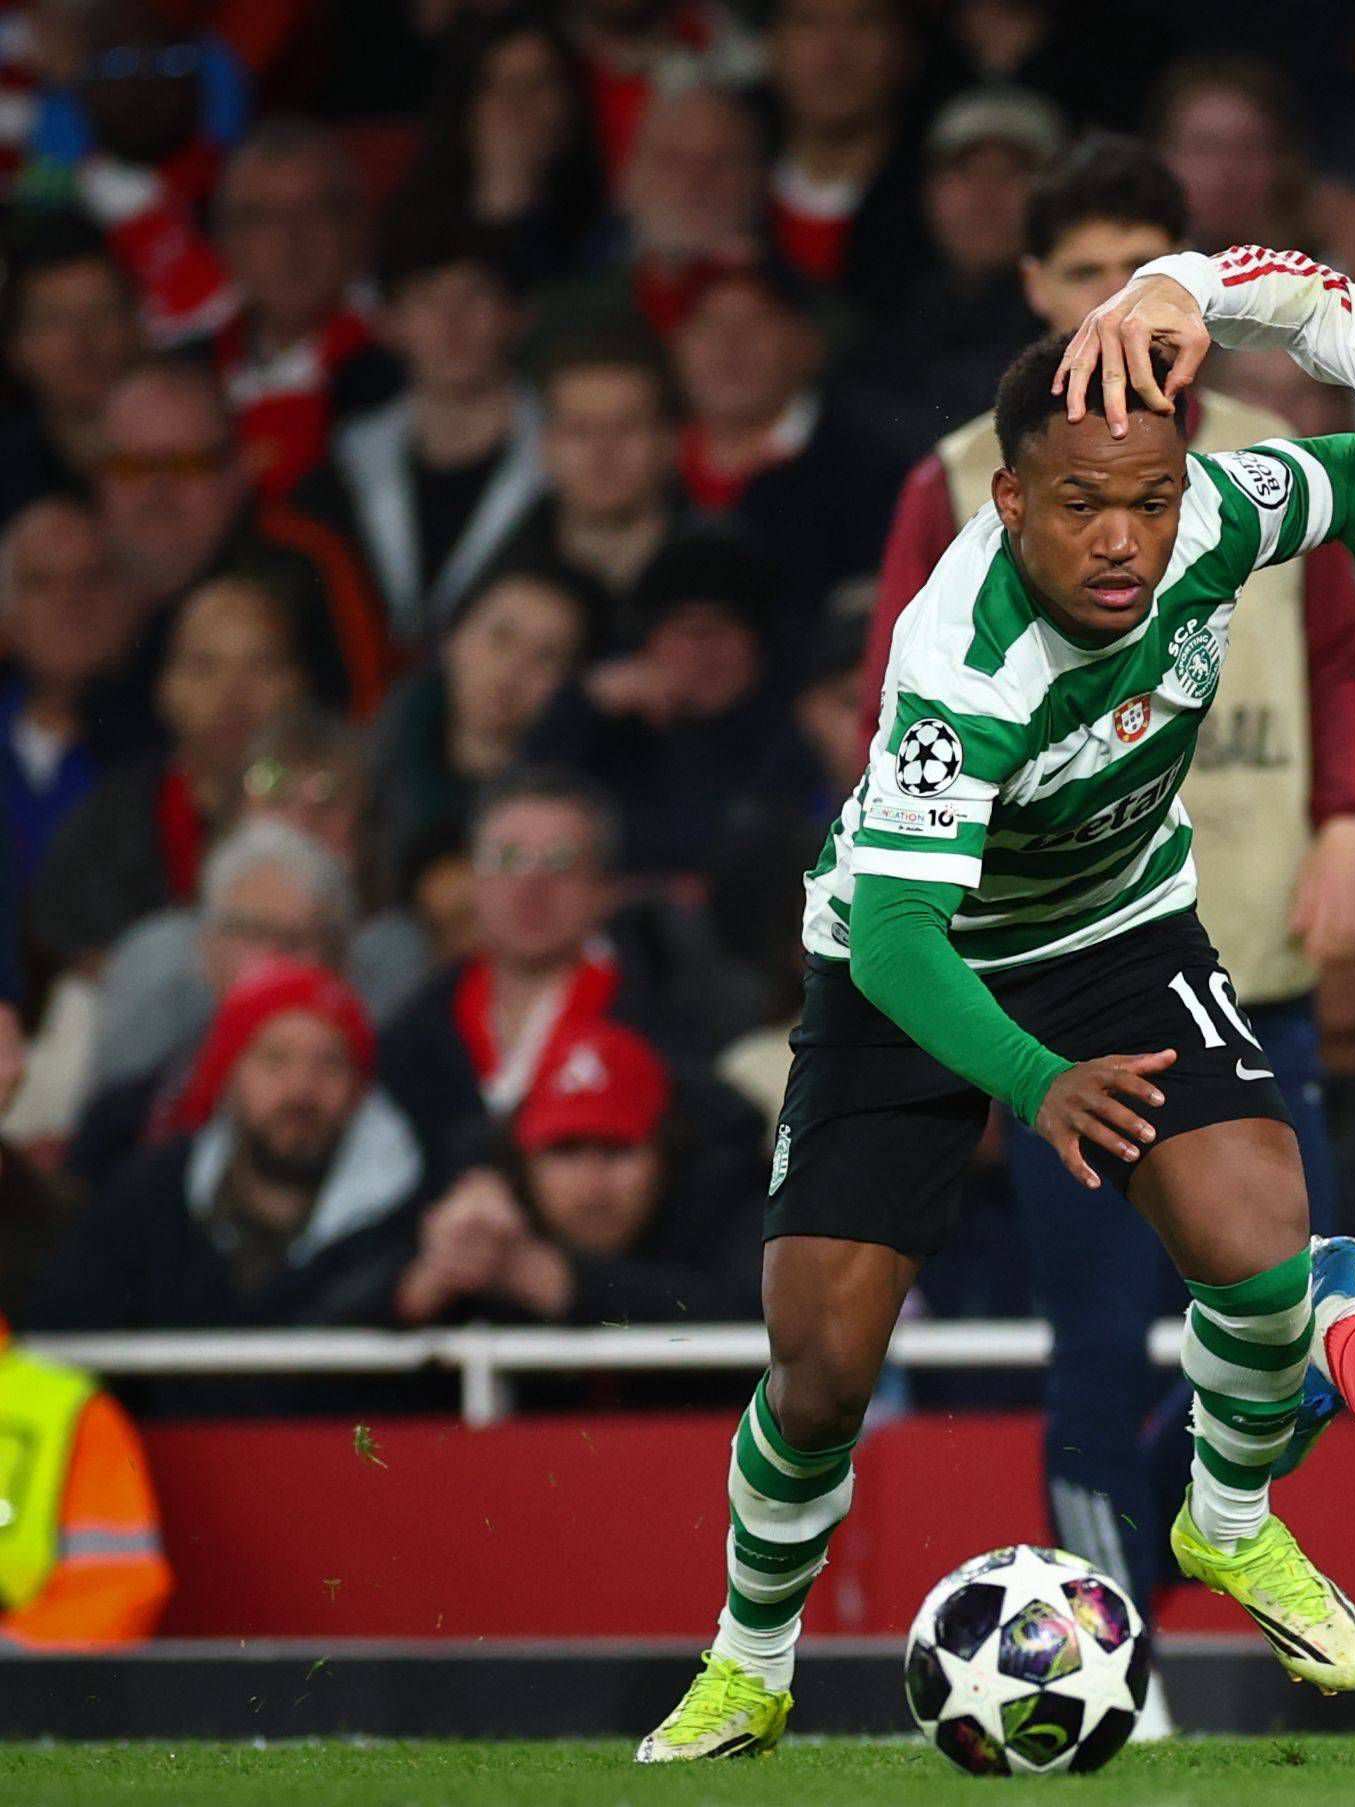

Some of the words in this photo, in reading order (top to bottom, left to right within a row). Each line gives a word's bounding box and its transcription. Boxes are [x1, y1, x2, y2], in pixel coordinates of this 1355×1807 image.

[1168, 619, 1198, 657] SCP
[1179, 635, 1209, 676] SPORTING
[869, 807, 925, 822] FNDATION
[928, 809, 954, 827] 10
